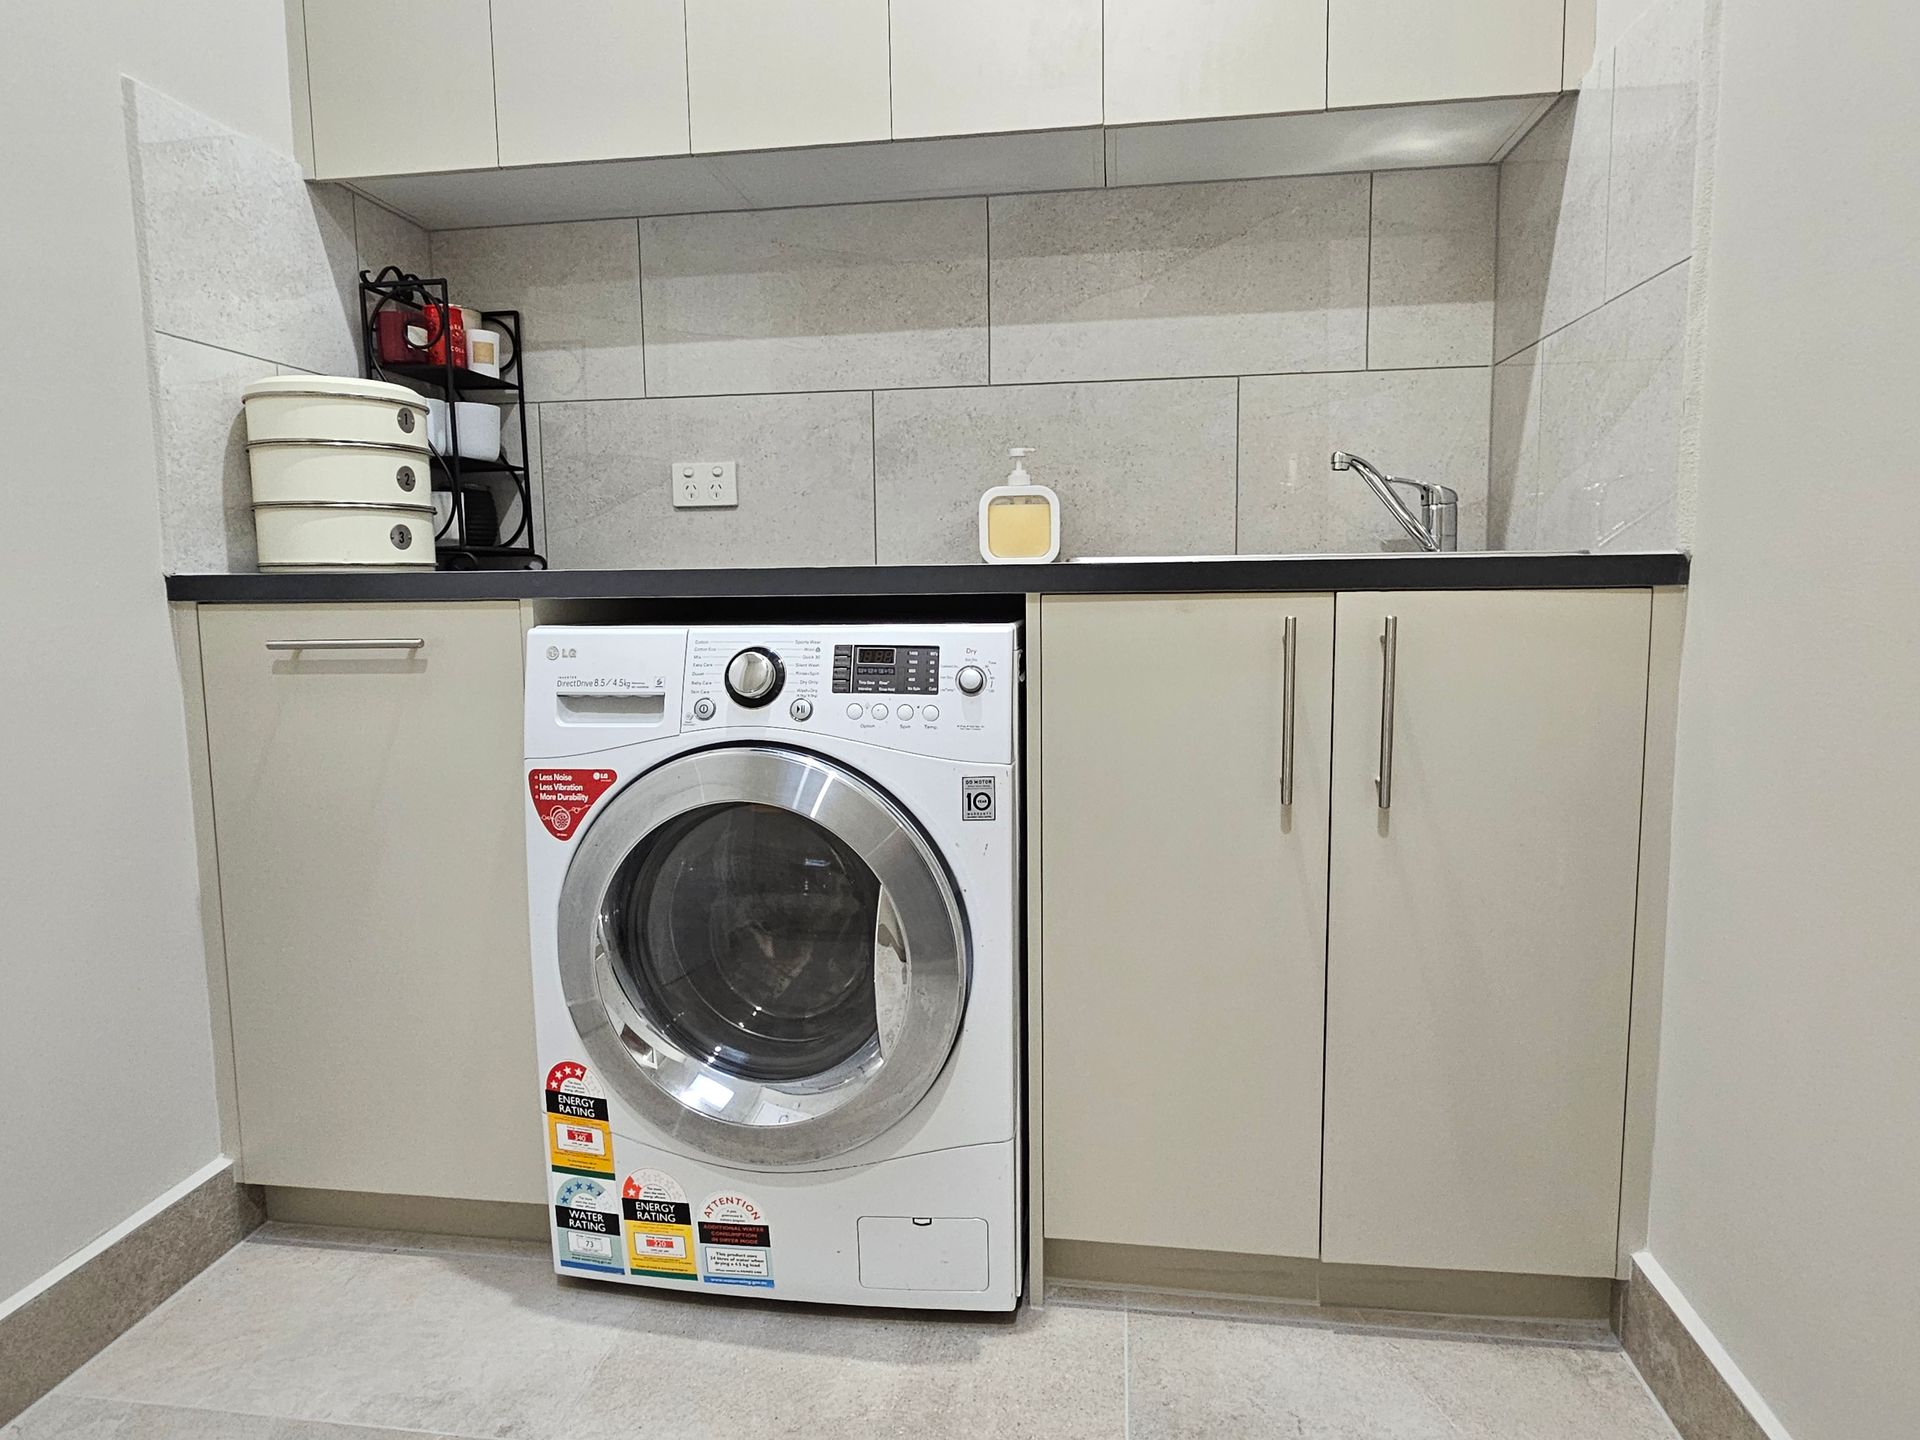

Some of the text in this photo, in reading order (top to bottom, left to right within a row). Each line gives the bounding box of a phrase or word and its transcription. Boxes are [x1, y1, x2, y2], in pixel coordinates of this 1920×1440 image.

[404, 414, 408, 425] 1
[405, 473, 410, 485] 2
[399, 531, 404, 543] 3
[558, 794, 588, 803] Durability
[967, 792, 991, 811] 10
[558, 1094, 595, 1108] ENERGY
[559, 1104, 595, 1117] RATING
[635, 1202, 675, 1213] ENERGY
[704, 1197, 760, 1220] ATTENTION
[569, 1209, 604, 1222] WATER
[636, 1211, 676, 1222] RATING
[569, 1219, 606, 1232] RATING
